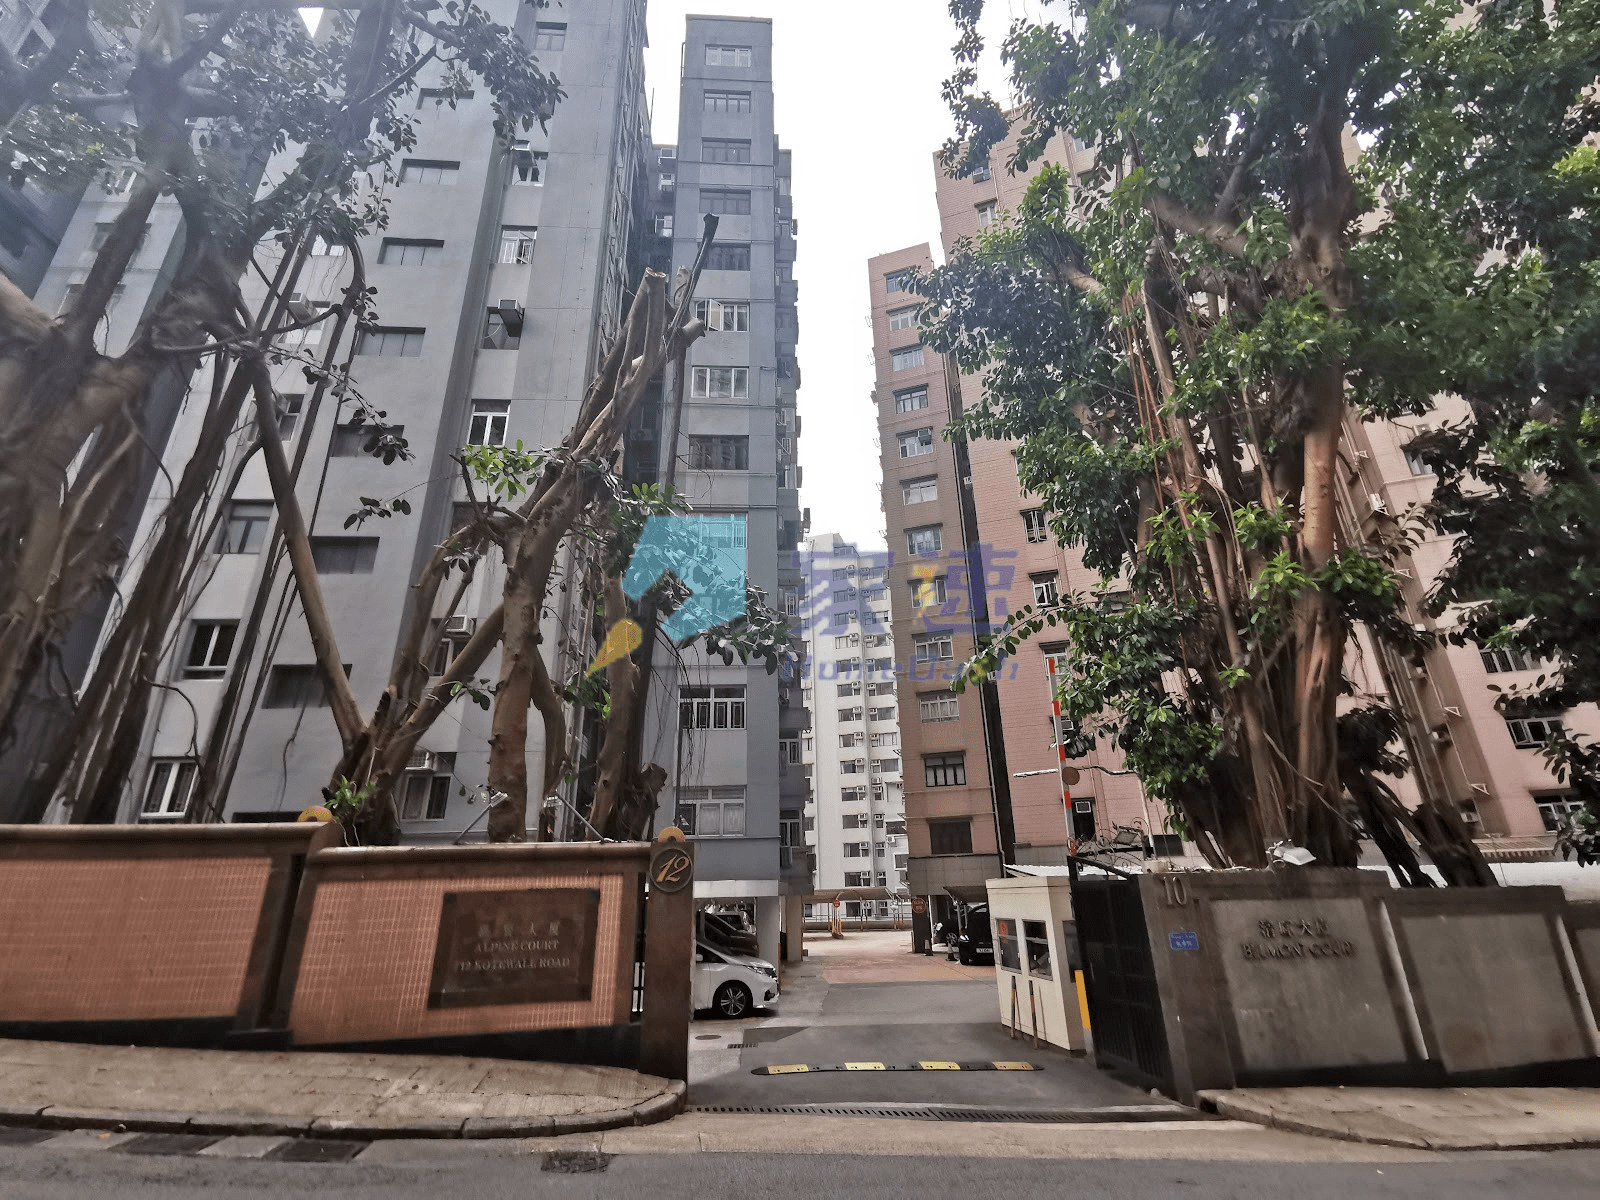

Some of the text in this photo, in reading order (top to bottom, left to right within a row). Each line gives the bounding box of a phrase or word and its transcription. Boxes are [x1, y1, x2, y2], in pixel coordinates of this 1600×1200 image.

[655, 854, 690, 883] 12
[1162, 876, 1188, 906] 10
[474, 939, 560, 953] ALPINE COURT
[474, 958, 537, 971] KOTEWALL
[539, 957, 570, 969] ROAD
